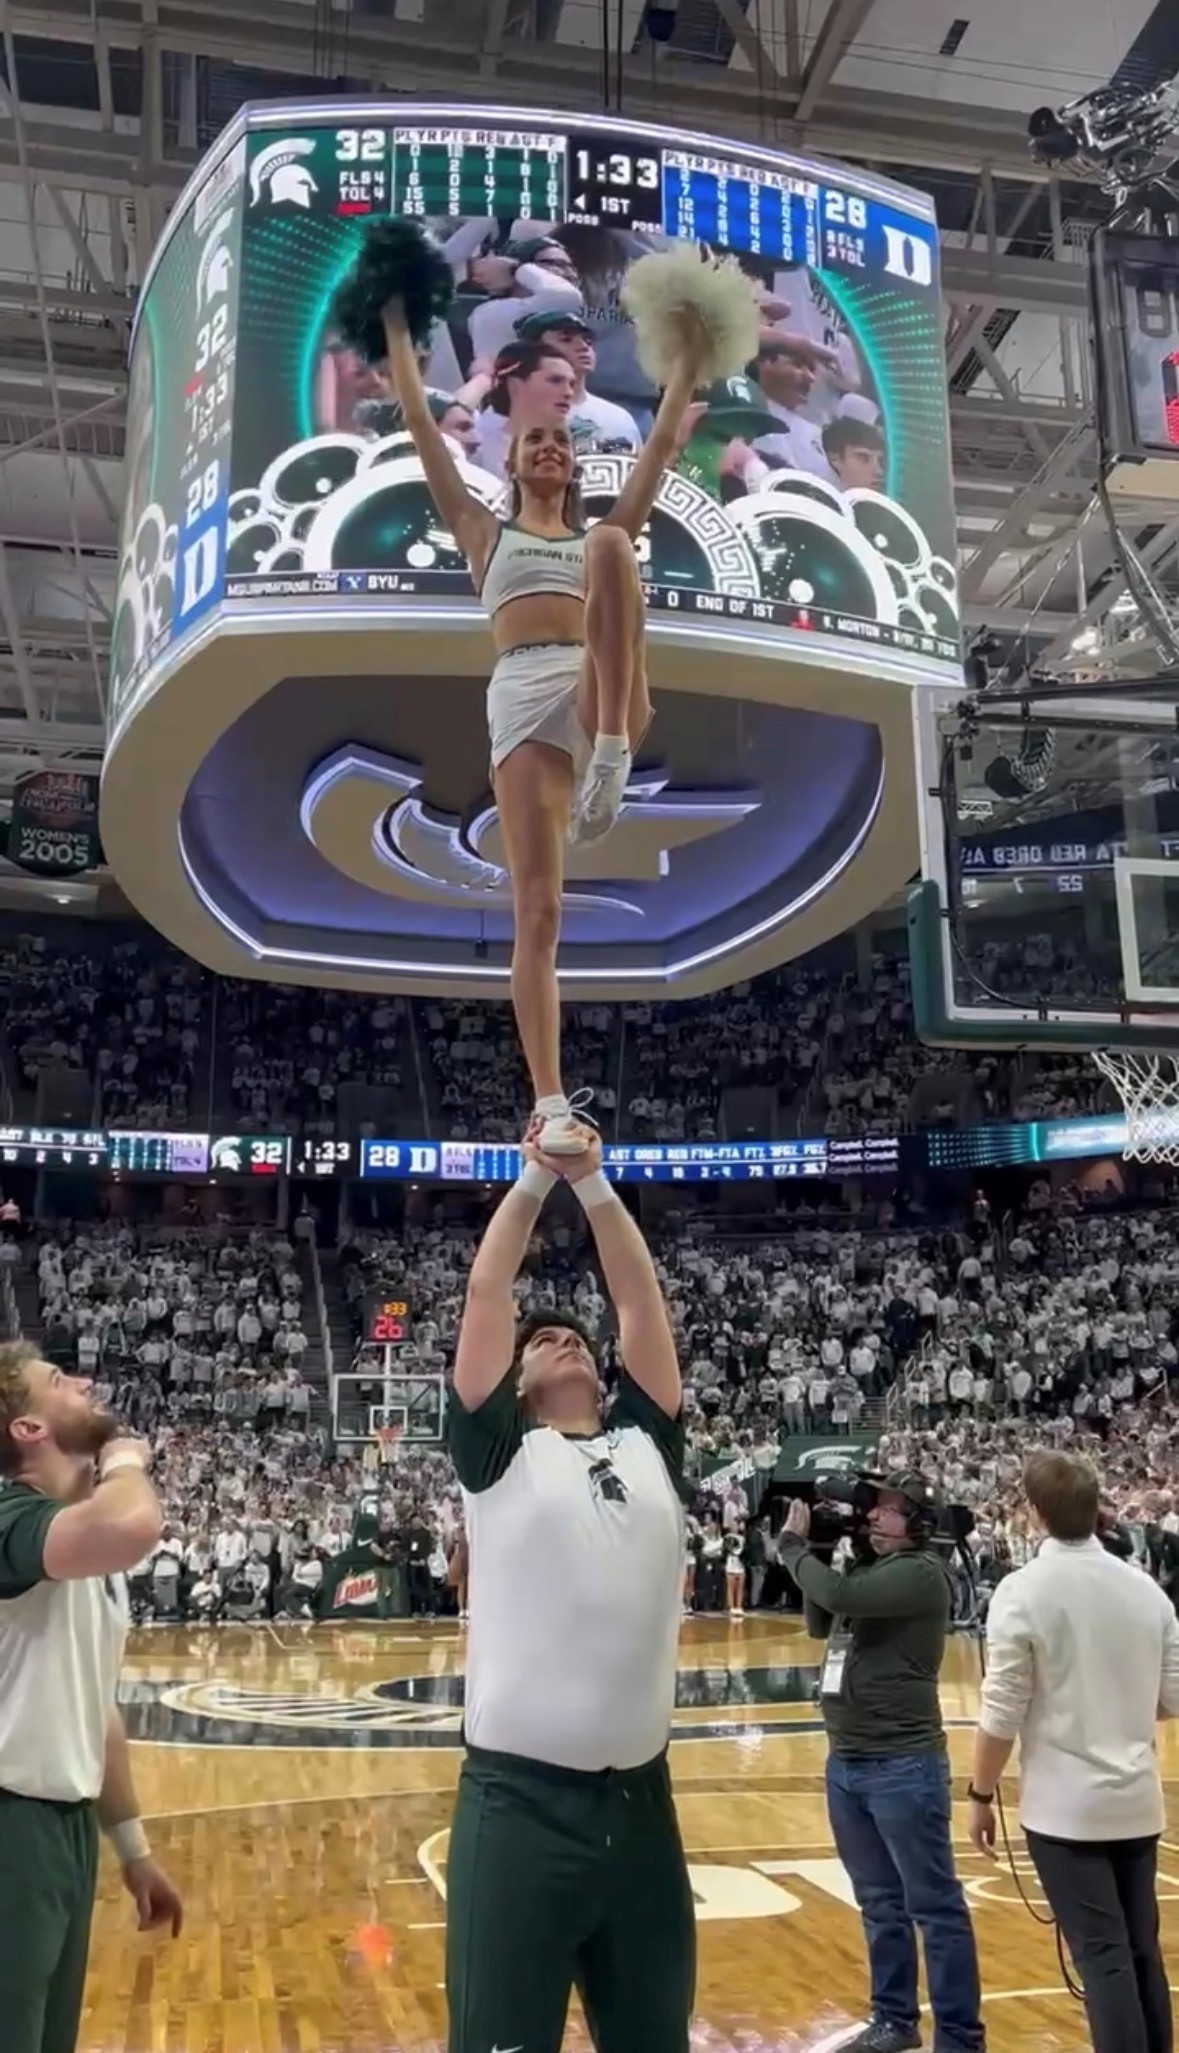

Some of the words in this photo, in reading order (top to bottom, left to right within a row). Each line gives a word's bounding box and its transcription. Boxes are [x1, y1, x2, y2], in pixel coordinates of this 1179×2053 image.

[335, 129, 385, 161] 32
[484, 146, 496, 160] 3
[449, 159, 460, 173] 2
[576, 149, 658, 189] 1:33
[374, 170, 385, 184] 4
[449, 173, 460, 187] 0
[484, 174, 496, 188] 4
[339, 186, 371, 201] TOL
[373, 186, 385, 200] 4
[406, 186, 424, 201] 15
[448, 187, 460, 201] 5
[485, 189, 496, 203] 7
[682, 183, 691, 196] 7
[403, 201, 425, 215] 55
[448, 202, 460, 216] 5
[601, 196, 630, 215] 1ST
[678, 197, 694, 212] 12
[825, 189, 866, 229] 28
[678, 212, 695, 227] 14
[839, 248, 866, 268] TOL
[882, 224, 932, 286] D
[195, 303, 228, 373] 32
[186, 459, 220, 529] 28
[368, 575, 399, 590] BYU
[696, 595, 723, 612] END
[729, 599, 747, 614] OF
[752, 603, 775, 619] 1ST
[21, 827, 90, 844] WOMEN'S
[19, 839, 89, 866] 2005
[88, 1152, 99, 1166] 3
[250, 1141, 283, 1164] 32
[303, 1140, 350, 1161] 1:33
[368, 1145, 400, 1168] 28
[409, 1147, 437, 1173] D
[615, 1166, 624, 1180] 7
[375, 1315, 403, 1340] 26
